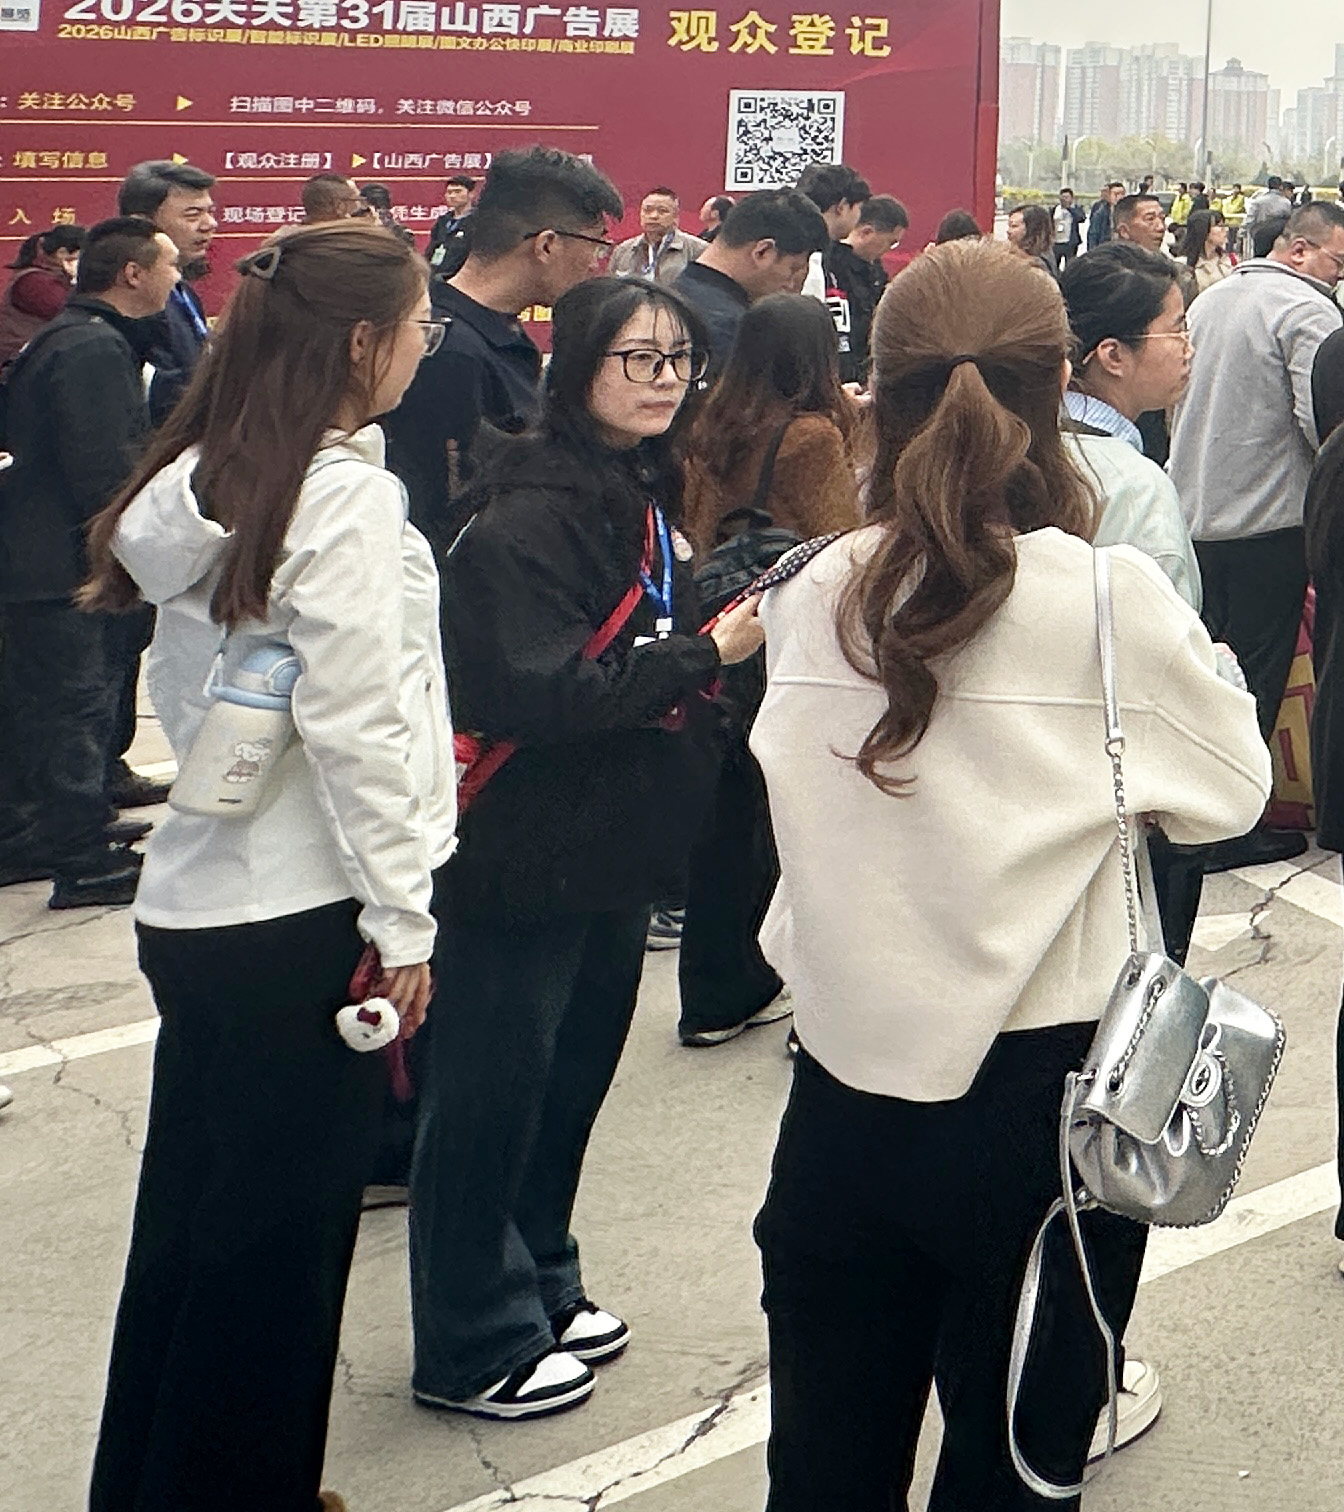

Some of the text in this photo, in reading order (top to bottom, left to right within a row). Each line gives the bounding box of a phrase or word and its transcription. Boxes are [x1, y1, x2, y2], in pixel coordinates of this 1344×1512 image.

[668, 9, 892, 57] 观众登记
[18, 92, 137, 112] 关注公众号
[13, 151, 108, 169] 填写信息
[222, 206, 306, 224] 现场登记
